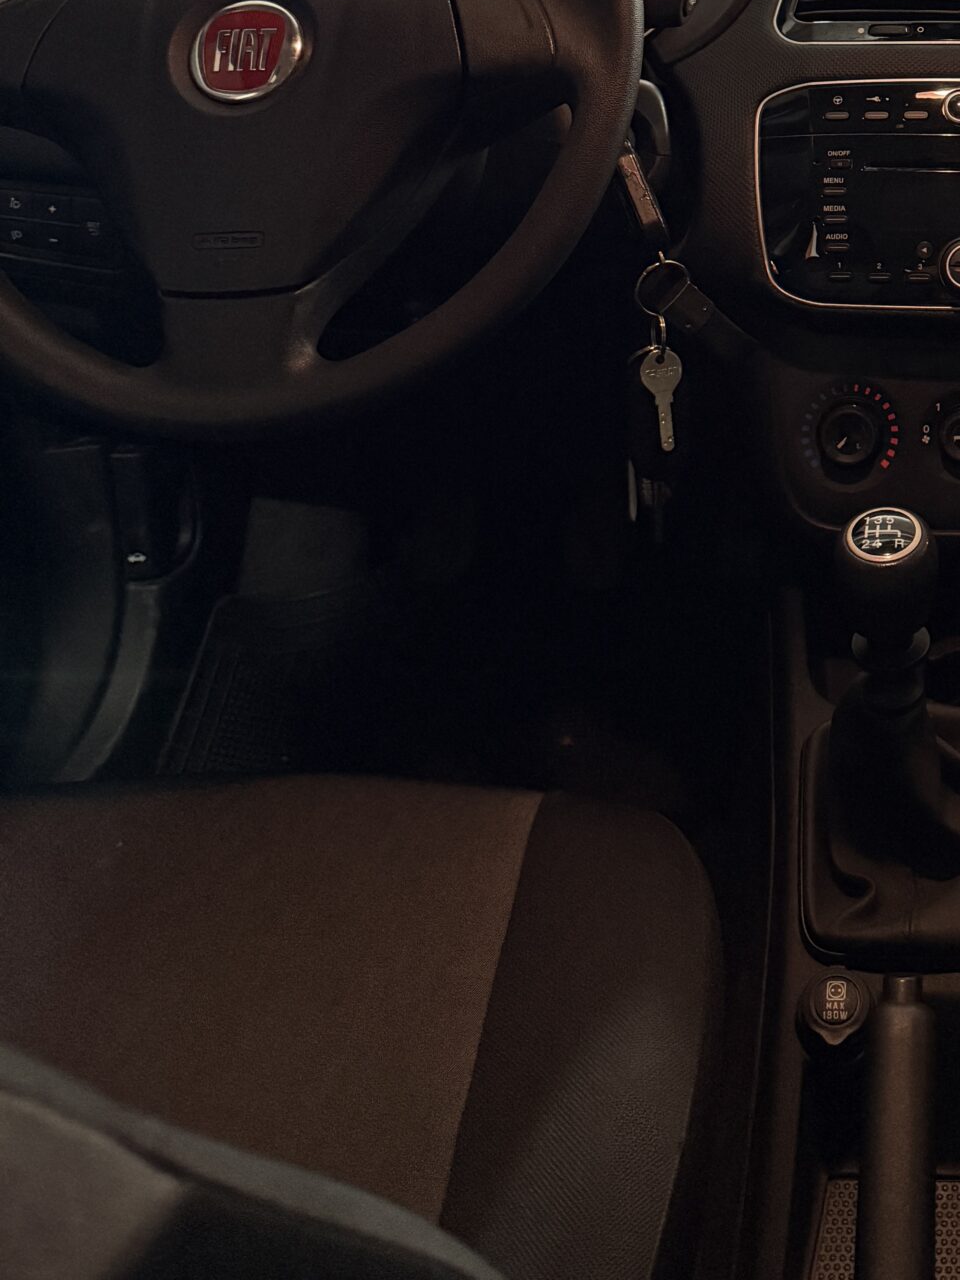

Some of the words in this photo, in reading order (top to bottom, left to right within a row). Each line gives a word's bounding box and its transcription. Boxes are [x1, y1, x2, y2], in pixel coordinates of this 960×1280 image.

[212, 27, 278, 73] FIAT
[935, 402, 941, 413] 1
[922, 425, 930, 434] 0
[873, 516, 882, 524] 3
[886, 516, 894, 524] 5
[861, 539, 870, 549] 2
[872, 539, 882, 549] 4
[894, 539, 904, 549] R
[825, 1001, 845, 1010] MAX
[822, 1010, 848, 1020] 180W
